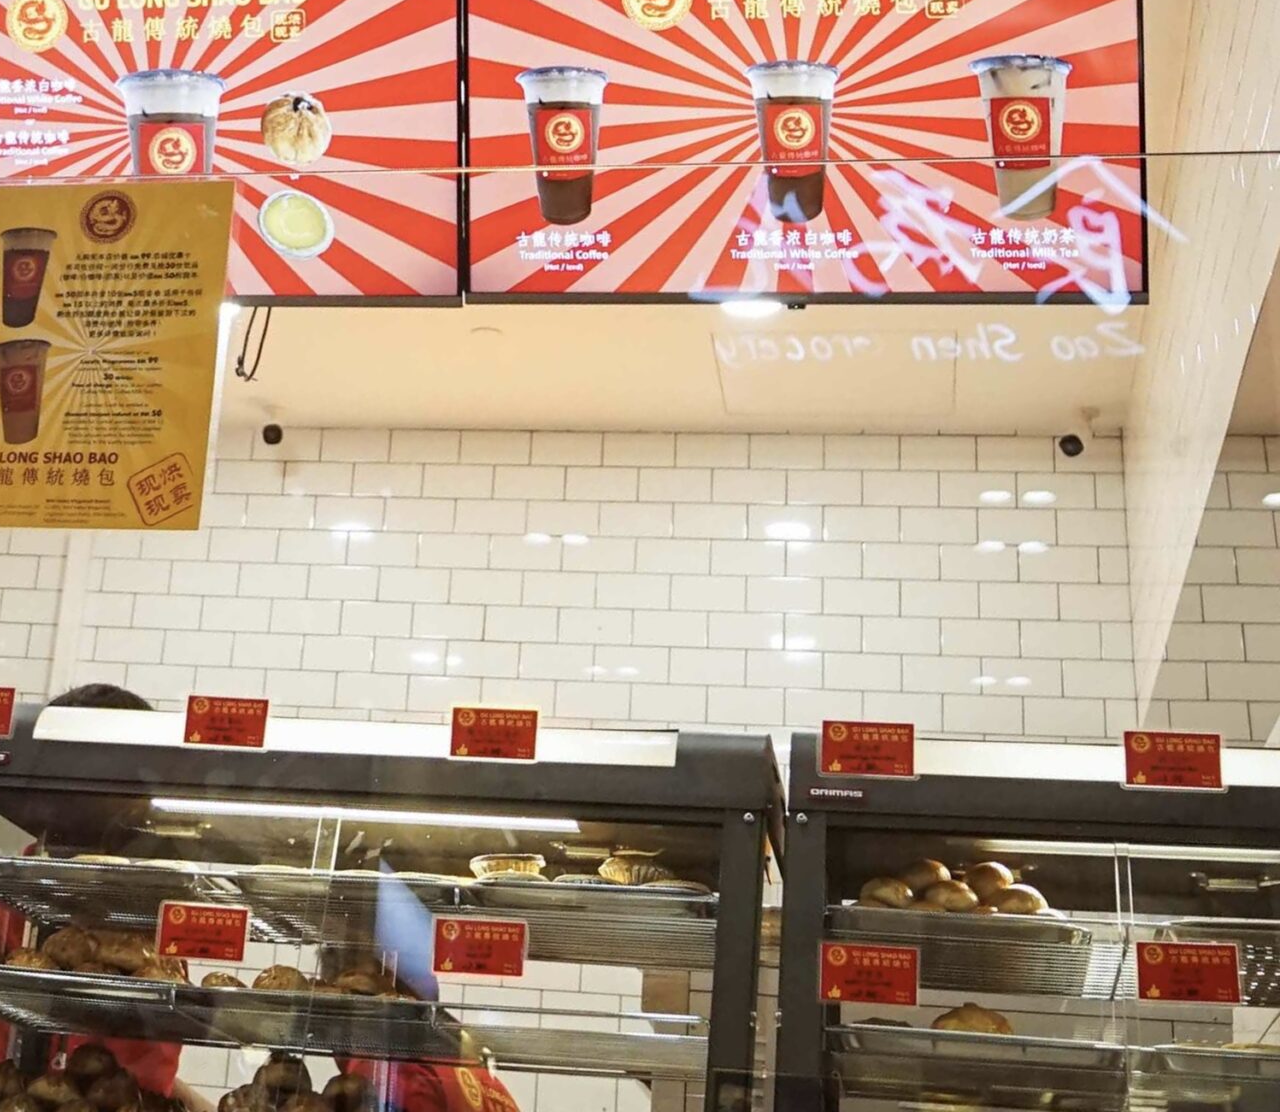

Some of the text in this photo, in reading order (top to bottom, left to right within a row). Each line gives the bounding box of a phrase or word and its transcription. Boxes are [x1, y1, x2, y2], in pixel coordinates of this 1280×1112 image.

[519, 250, 609, 260] Traditional Coffee
[730, 248, 859, 259] Traditional White Coffee
[970, 247, 1079, 258] Traditional Milk Tea
[43, 451, 84, 465] SHAO
[88, 452, 119, 465] BAO
